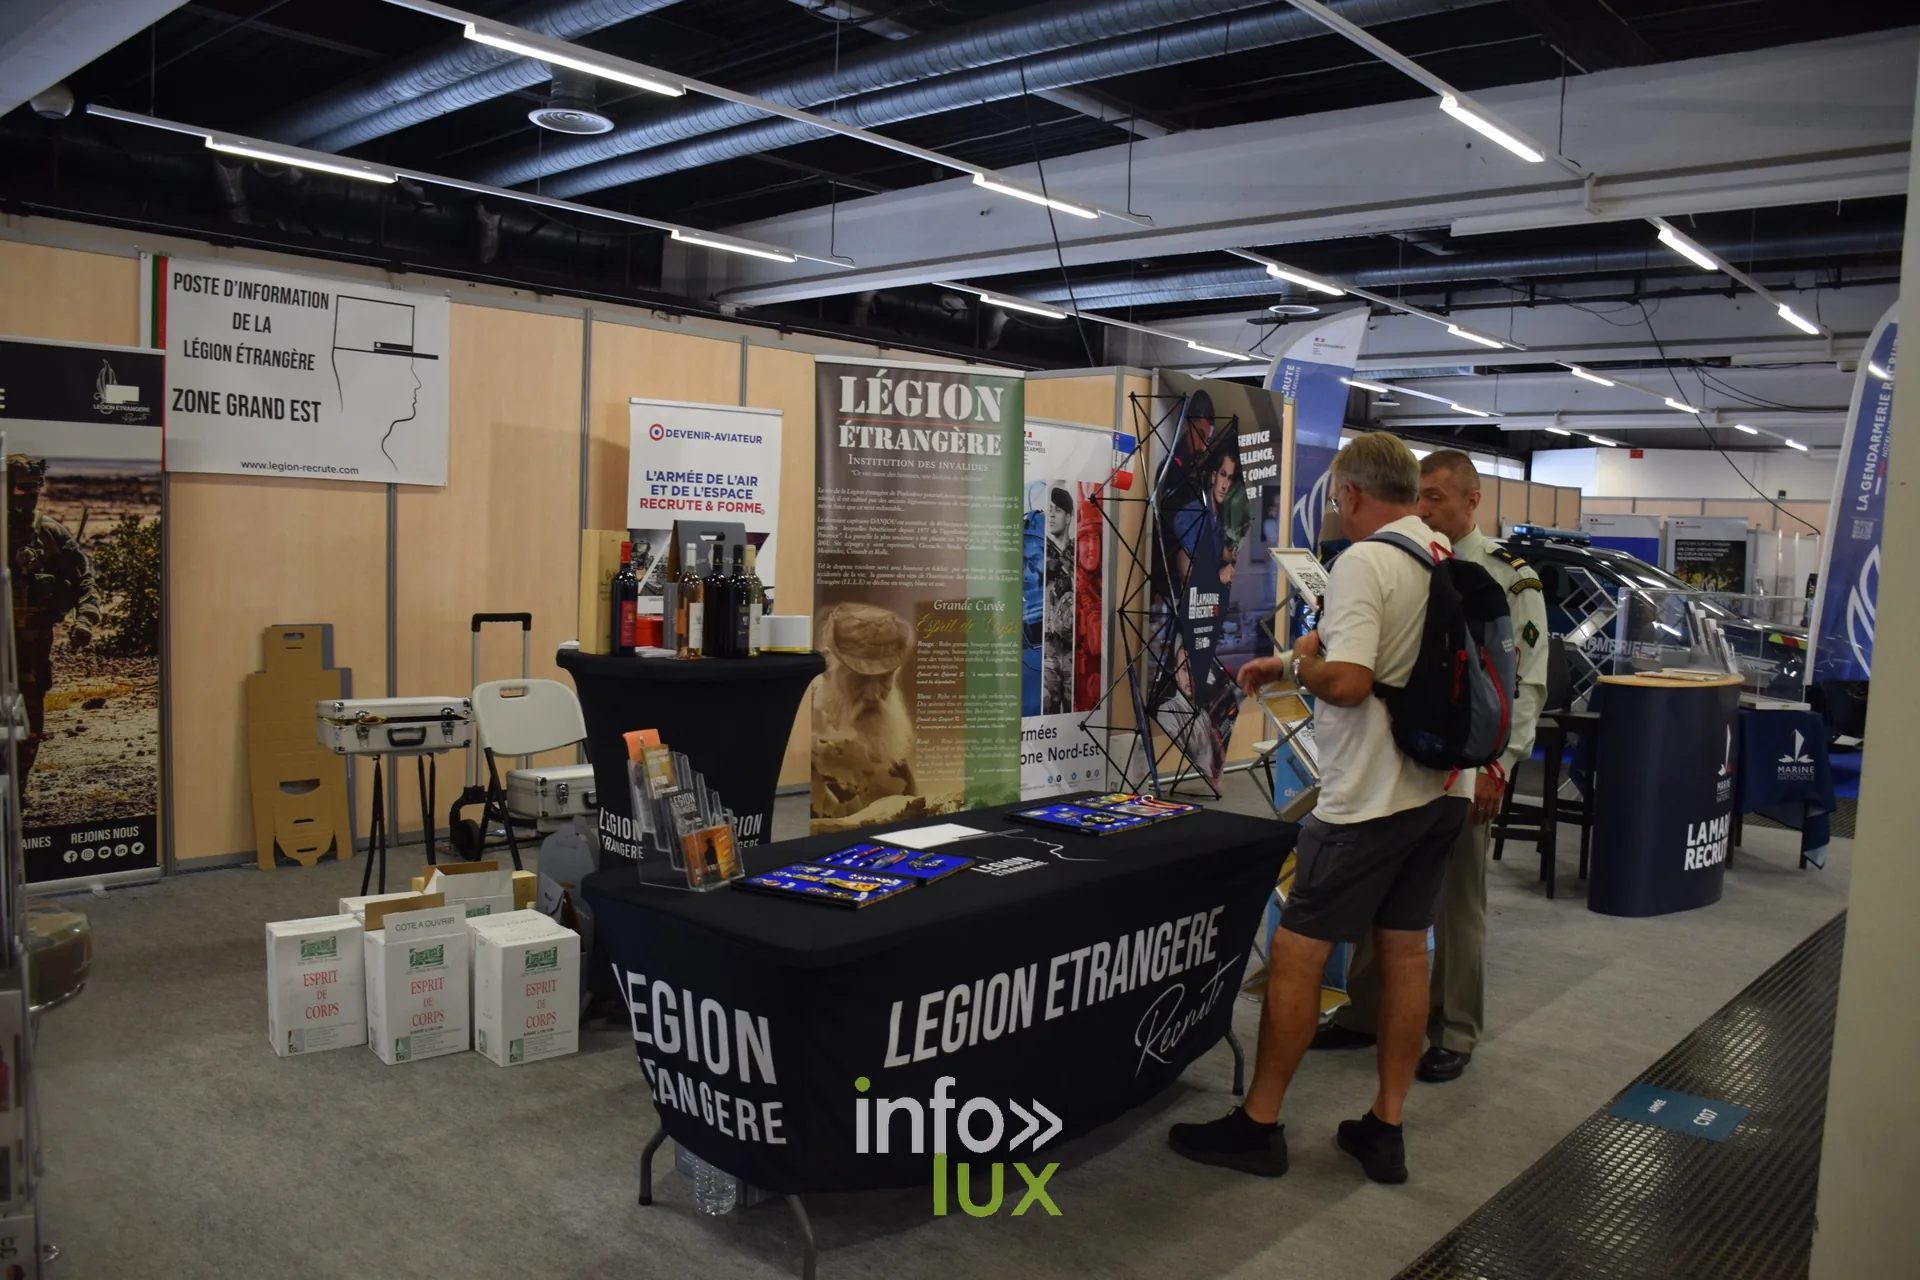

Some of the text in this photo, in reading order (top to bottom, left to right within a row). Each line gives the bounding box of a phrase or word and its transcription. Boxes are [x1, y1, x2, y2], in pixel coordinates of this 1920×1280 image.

[173, 272, 220, 297] POSTE
[233, 312, 272, 334] DE LA
[183, 337, 315, 372] LÉGION ÉTRANGÈRE
[839, 369, 1004, 423] LÉGION
[172, 387, 321, 424] ZONE GRAND EST
[665, 428, 763, 444] DEVENIR-AVIATEUR
[838, 420, 1001, 456] ÉTRANGÈRE
[1860, 394, 1891, 491] GENDARMERIE
[241, 460, 359, 475] www.legion-recrute.com
[918, 460, 936, 469] DES
[938, 462, 988, 471] INVALIDES
[1248, 464, 1277, 482] COMME
[706, 473, 723, 485] DE
[651, 485, 668, 496] ET
[671, 486, 690, 497] DE
[640, 497, 762, 514] RECRUTE & FORME
[1856, 494, 1870, 511] LA
[870, 517, 897, 525] DANJOU
[933, 598, 1006, 612] Grande Cuvée
[917, 640, 934, 648] Rouge
[1021, 724, 1057, 742] rmées
[1021, 752, 1043, 766] one
[1048, 743, 1100, 762] Nord-Est
[1777, 766, 1814, 774] MARINE
[599, 806, 643, 842] LEGION
[70, 826, 140, 844] REJOINS NOUS
[1686, 821, 1707, 847] LA
[970, 856, 1034, 873] LEGION
[395, 922, 417, 932] COTE
[425, 916, 455, 928] OUVRIR
[303, 969, 339, 987] ESPRIT
[411, 977, 445, 995] ESPRIT
[884, 904, 1225, 1068] LEGION ETRANGERE
[317, 989, 327, 1000] DE
[526, 979, 557, 997] ESPRIT
[305, 1002, 340, 1020] CORPS
[423, 997, 433, 1008] DE
[537, 999, 547, 1009] DE
[412, 1010, 445, 1027] CORPS
[525, 1012, 557, 1029] CORPS
[1134, 953, 1242, 1081] Recrute
[1692, 1108, 1719, 1126] C107
